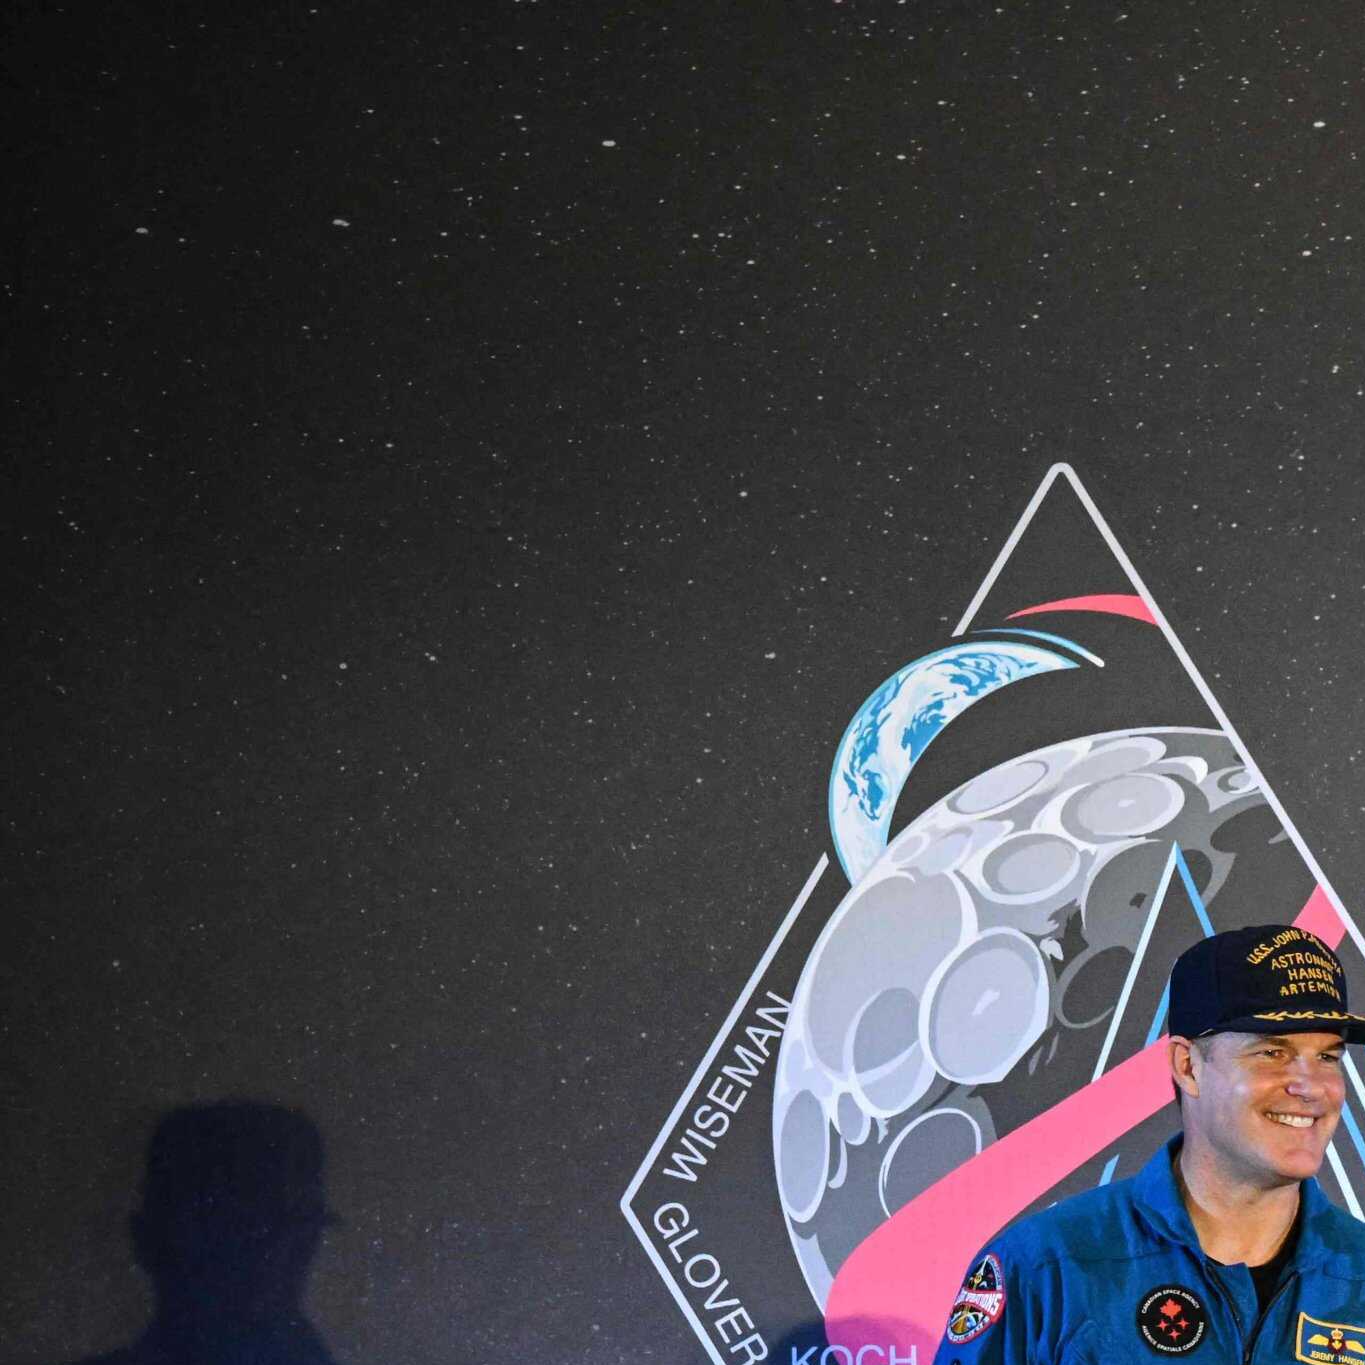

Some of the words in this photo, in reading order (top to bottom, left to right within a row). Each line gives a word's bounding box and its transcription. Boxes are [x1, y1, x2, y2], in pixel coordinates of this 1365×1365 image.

[1272, 930, 1301, 949] JOHN
[1287, 967, 1334, 985] HANSEN
[663, 991, 792, 1182] WISEMAN
